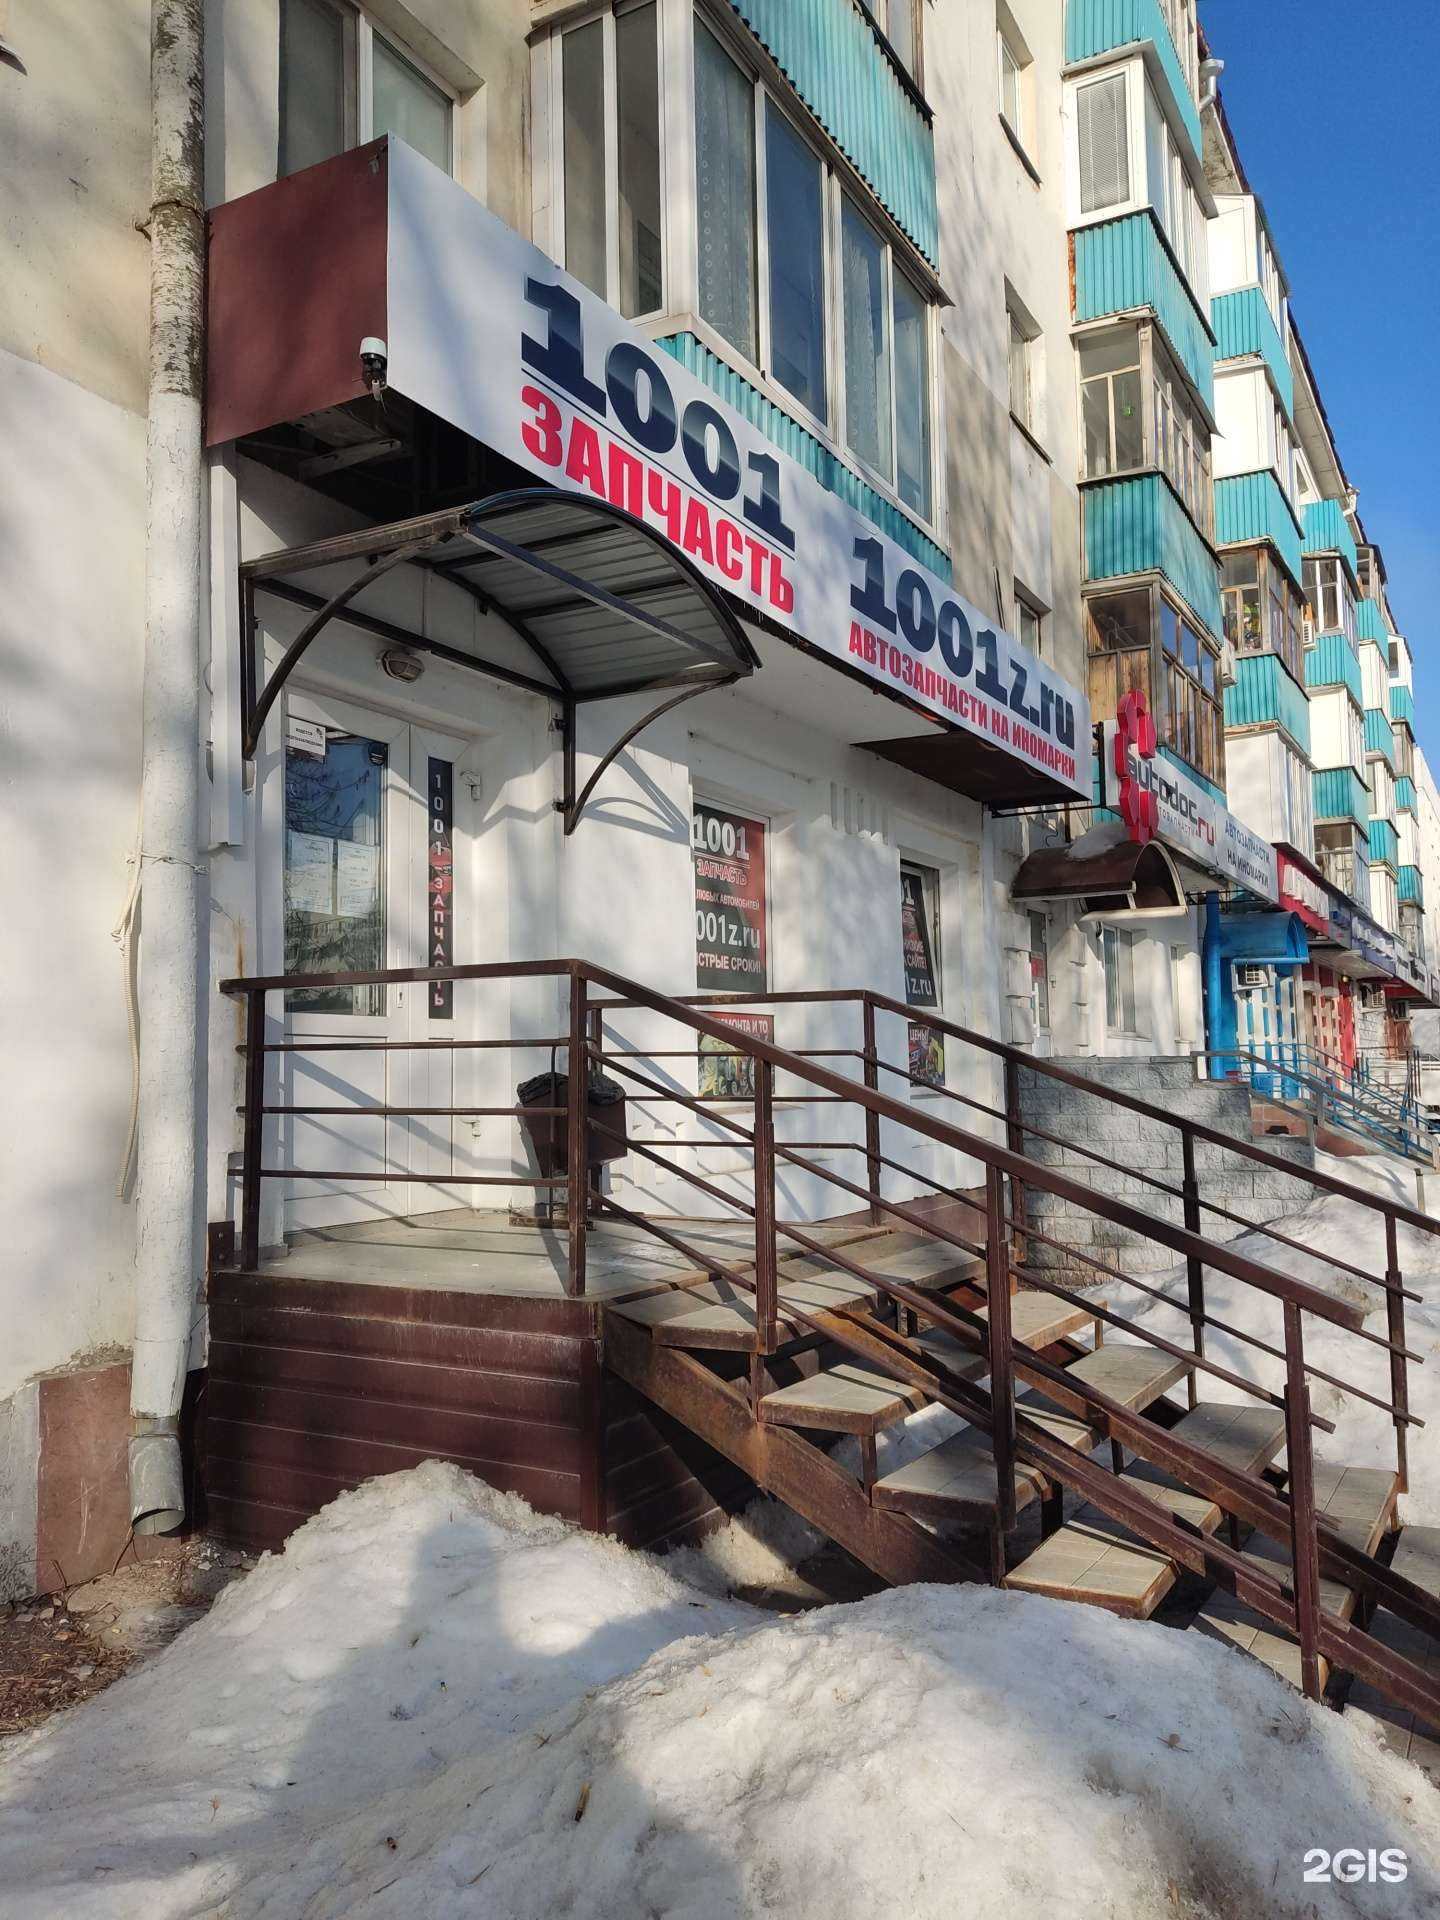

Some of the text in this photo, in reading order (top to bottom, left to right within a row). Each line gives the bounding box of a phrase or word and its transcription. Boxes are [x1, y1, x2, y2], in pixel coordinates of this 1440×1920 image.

[521, 276, 796, 552] 1001
[521, 385, 794, 614] ЗАПЧАСТЬ
[849, 537, 1075, 750] 1001z.ru
[849, 621, 1076, 781] АВТОЗАПЧАСТИ НА ИНОМАРКИ
[692, 814, 750, 860] 1001
[697, 859, 748, 886] ЗАПЧАСТЬ
[696, 910, 760, 948] 001z.ru
[697, 952, 729, 970] СТРЫЕ
